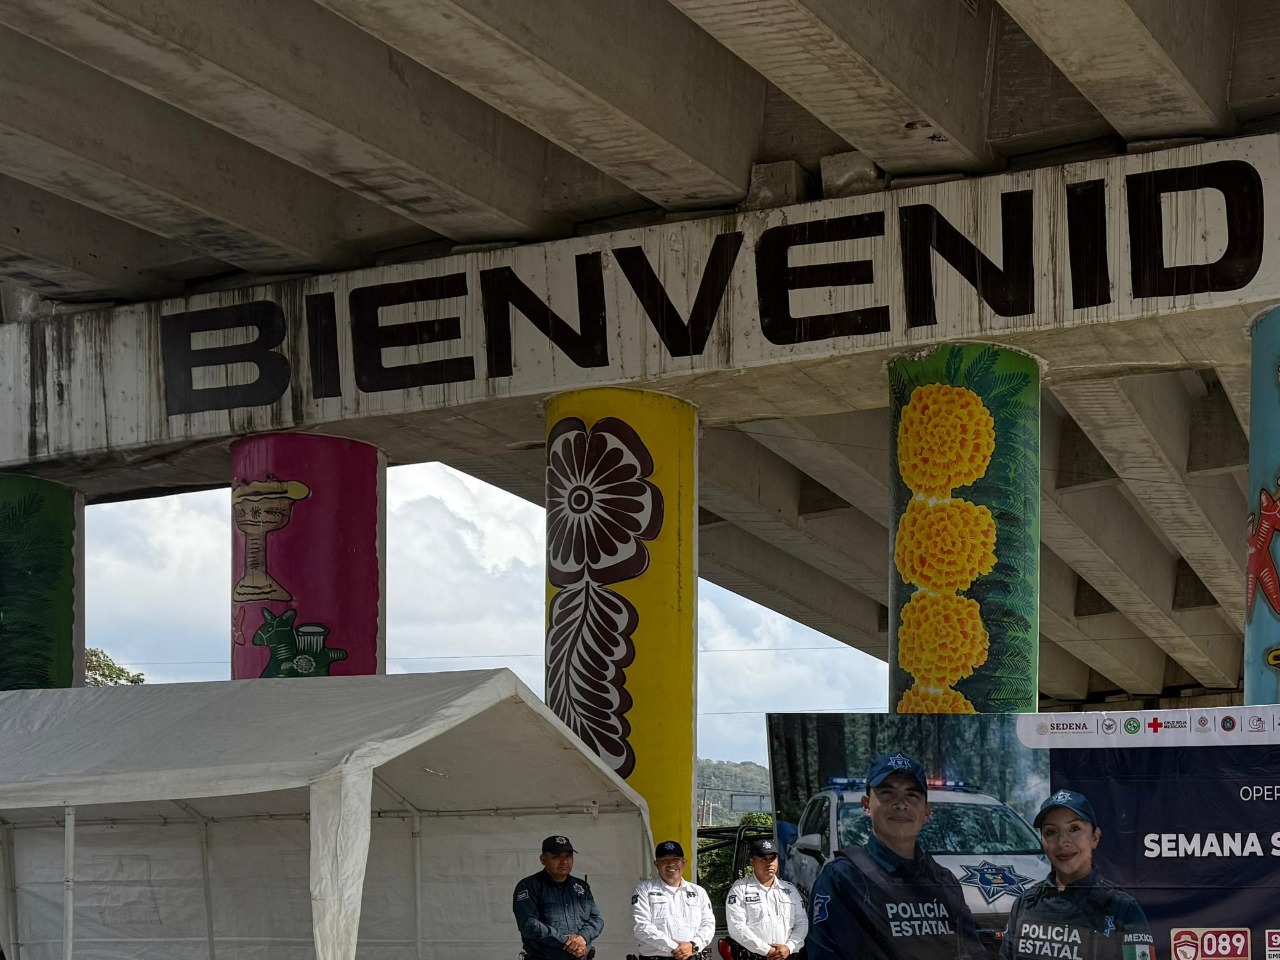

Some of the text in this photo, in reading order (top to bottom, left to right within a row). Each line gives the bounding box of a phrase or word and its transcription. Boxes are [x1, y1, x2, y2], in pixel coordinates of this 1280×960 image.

[1050, 722, 1088, 731] SEDENA
[1143, 832, 1264, 858] SEMANA
[885, 898, 950, 919] POLICÍA
[889, 920, 955, 937] ESTATAL
[1203, 933, 1246, 956] 089
